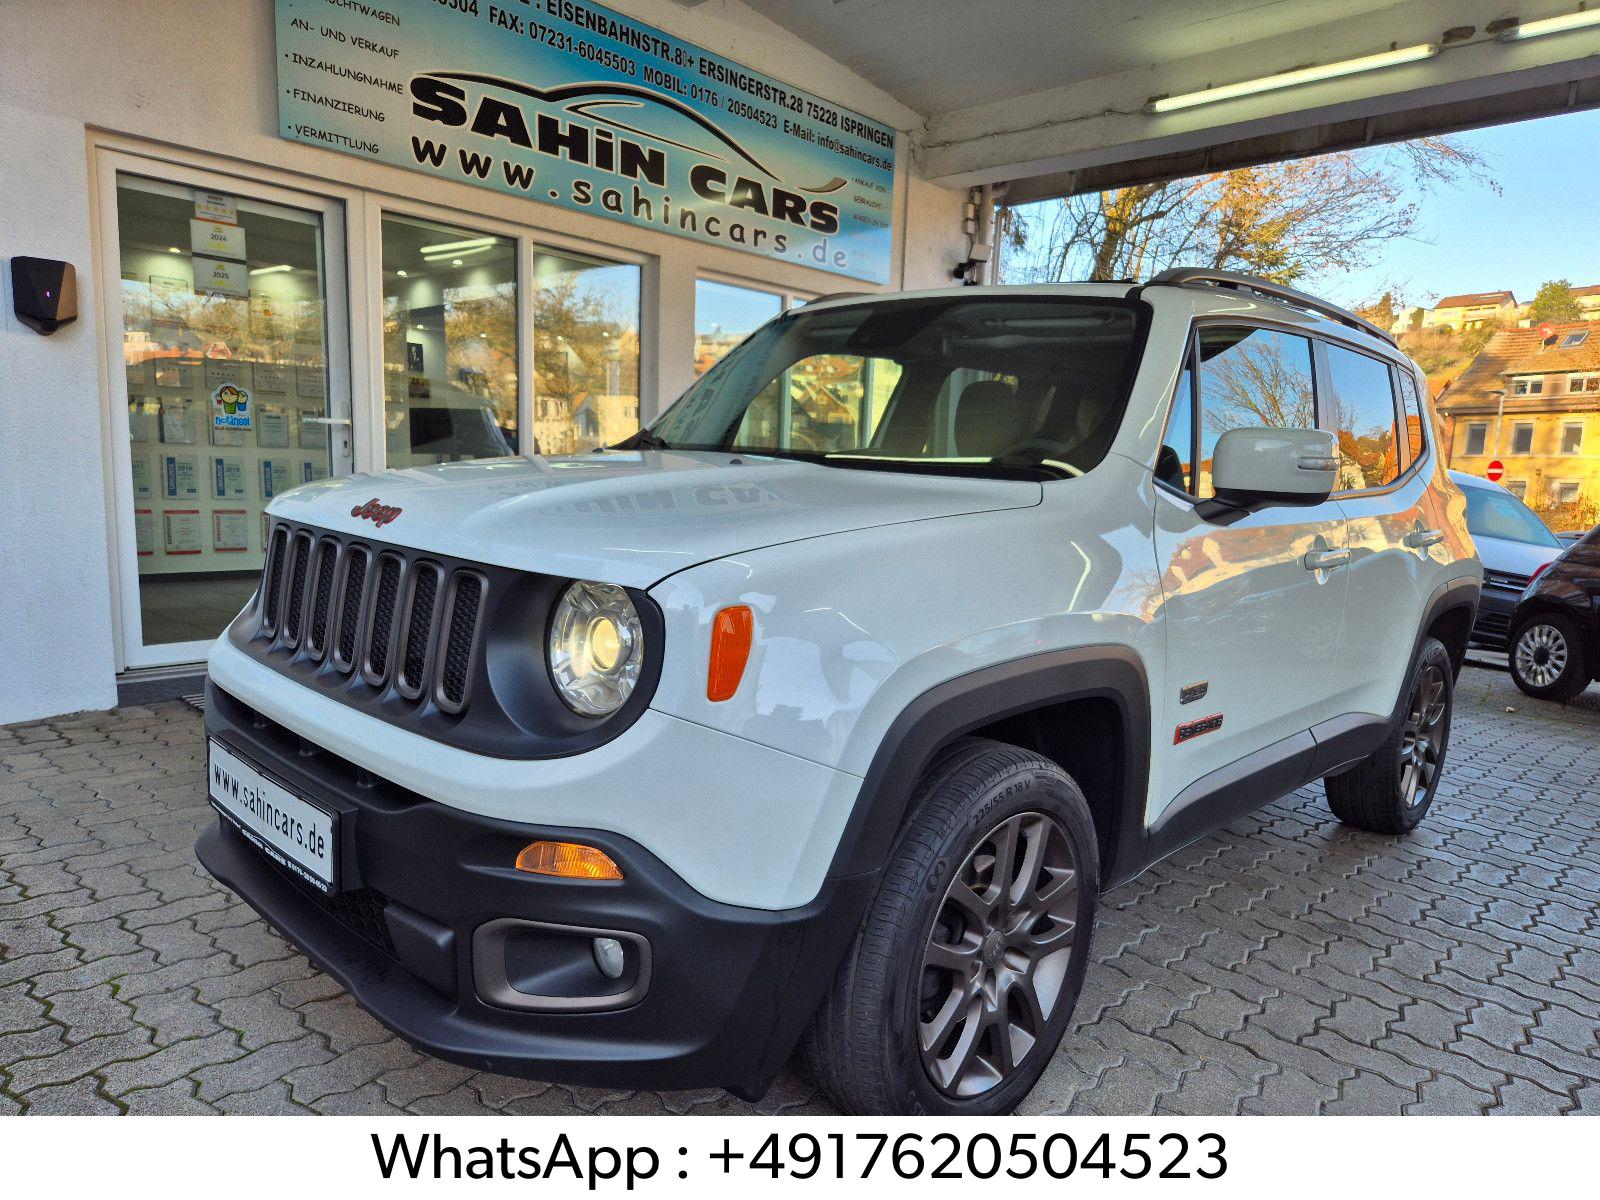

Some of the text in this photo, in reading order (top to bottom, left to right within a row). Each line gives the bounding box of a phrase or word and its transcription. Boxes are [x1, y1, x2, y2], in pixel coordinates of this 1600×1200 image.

[290, 18, 399, 59] AN- UND VERKAUF
[292, 52, 403, 95] INZAHLUNGNAHME
[489, 5, 524, 35] FAX:
[529, 21, 636, 76] 07231-6045503
[643, 65, 688, 96] MOBIL:
[690, 84, 718, 107] 0176
[727, 98, 778, 130] 20504523
[783, 119, 815, 143] E-Mail:
[817, 132, 892, 172] info@sahincars.de
[293, 88, 385, 122] FINANZIERUNG
[700, 57, 804, 114] ERSINGERSTR.28
[806, 102, 838, 128] 75228
[840, 115, 894, 150] ISPRINGEN
[295, 124, 379, 154] VERMITTLUNG
[690, 164, 838, 234] CARS
[210, 233, 227, 241] 2024
[1006, 786, 1013, 798] R
[1014, 781, 1023, 793] 18
[214, 763, 324, 859] www.sahincars.de
